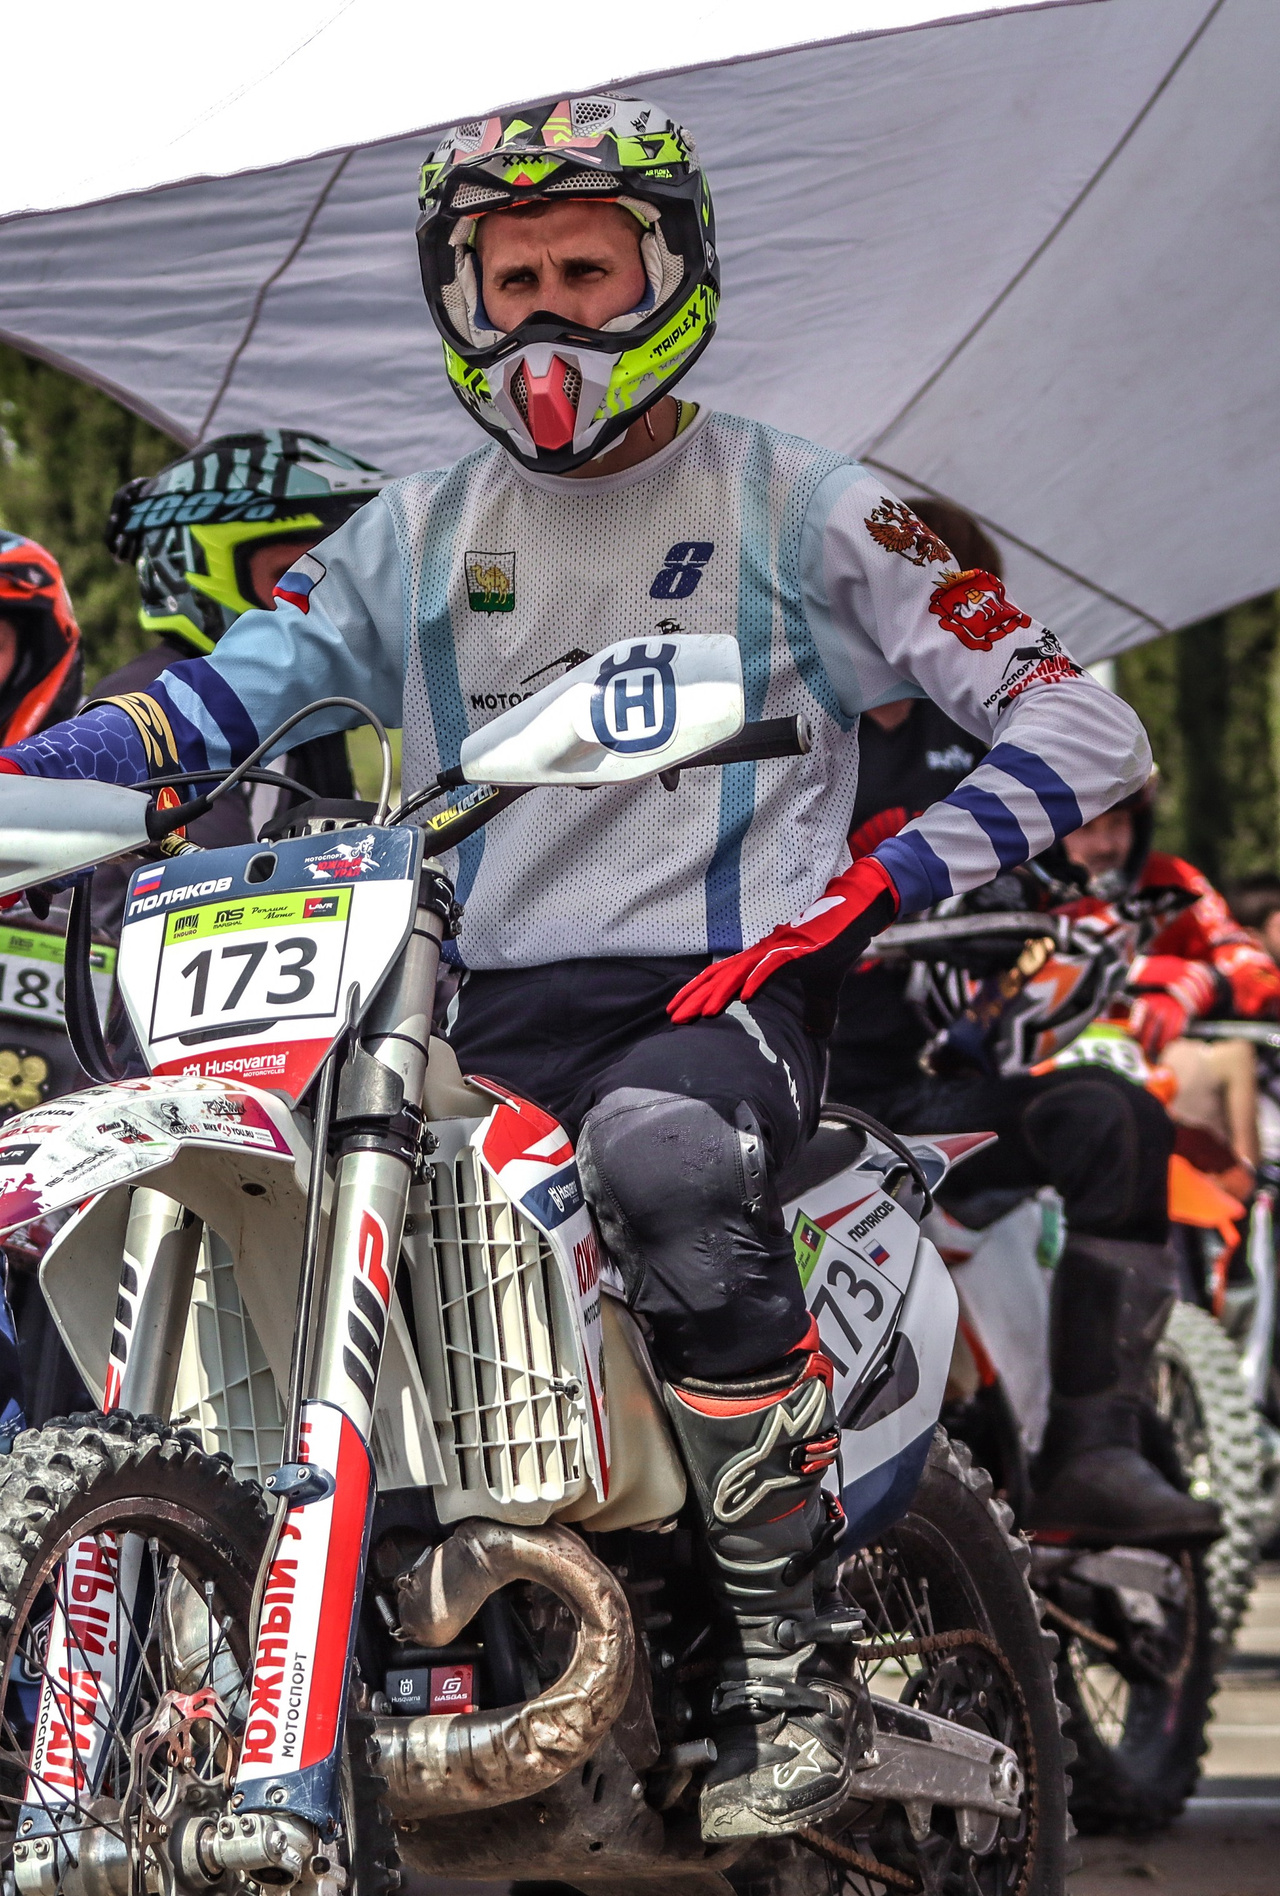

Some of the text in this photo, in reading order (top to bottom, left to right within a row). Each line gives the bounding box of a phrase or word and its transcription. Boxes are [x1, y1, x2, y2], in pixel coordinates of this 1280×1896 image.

[124, 490, 277, 533] 100%
[650, 541, 715, 600] 8
[983, 659, 1035, 709] МОТОСПОРТ
[304, 853, 344, 864] МОТОСПОРТ
[128, 876, 233, 917] ПОЛЯКОВ
[308, 902, 334, 911] LAVR
[213, 920, 243, 930] MARSHAL
[173, 929, 198, 940] ENDURO
[181, 937, 318, 1018] 173
[205, 1053, 286, 1076] Husqvarna
[243, 1069, 286, 1078] MOTORCYCLES
[27, 1109, 74, 1118] KENDA
[847, 1199, 896, 1243] ПОЛЯКОВ
[281, 1651, 309, 1759] МОТОСПОРТ
[391, 1695, 421, 1704] Husqvarna
[434, 1693, 468, 1702] GASGAS
